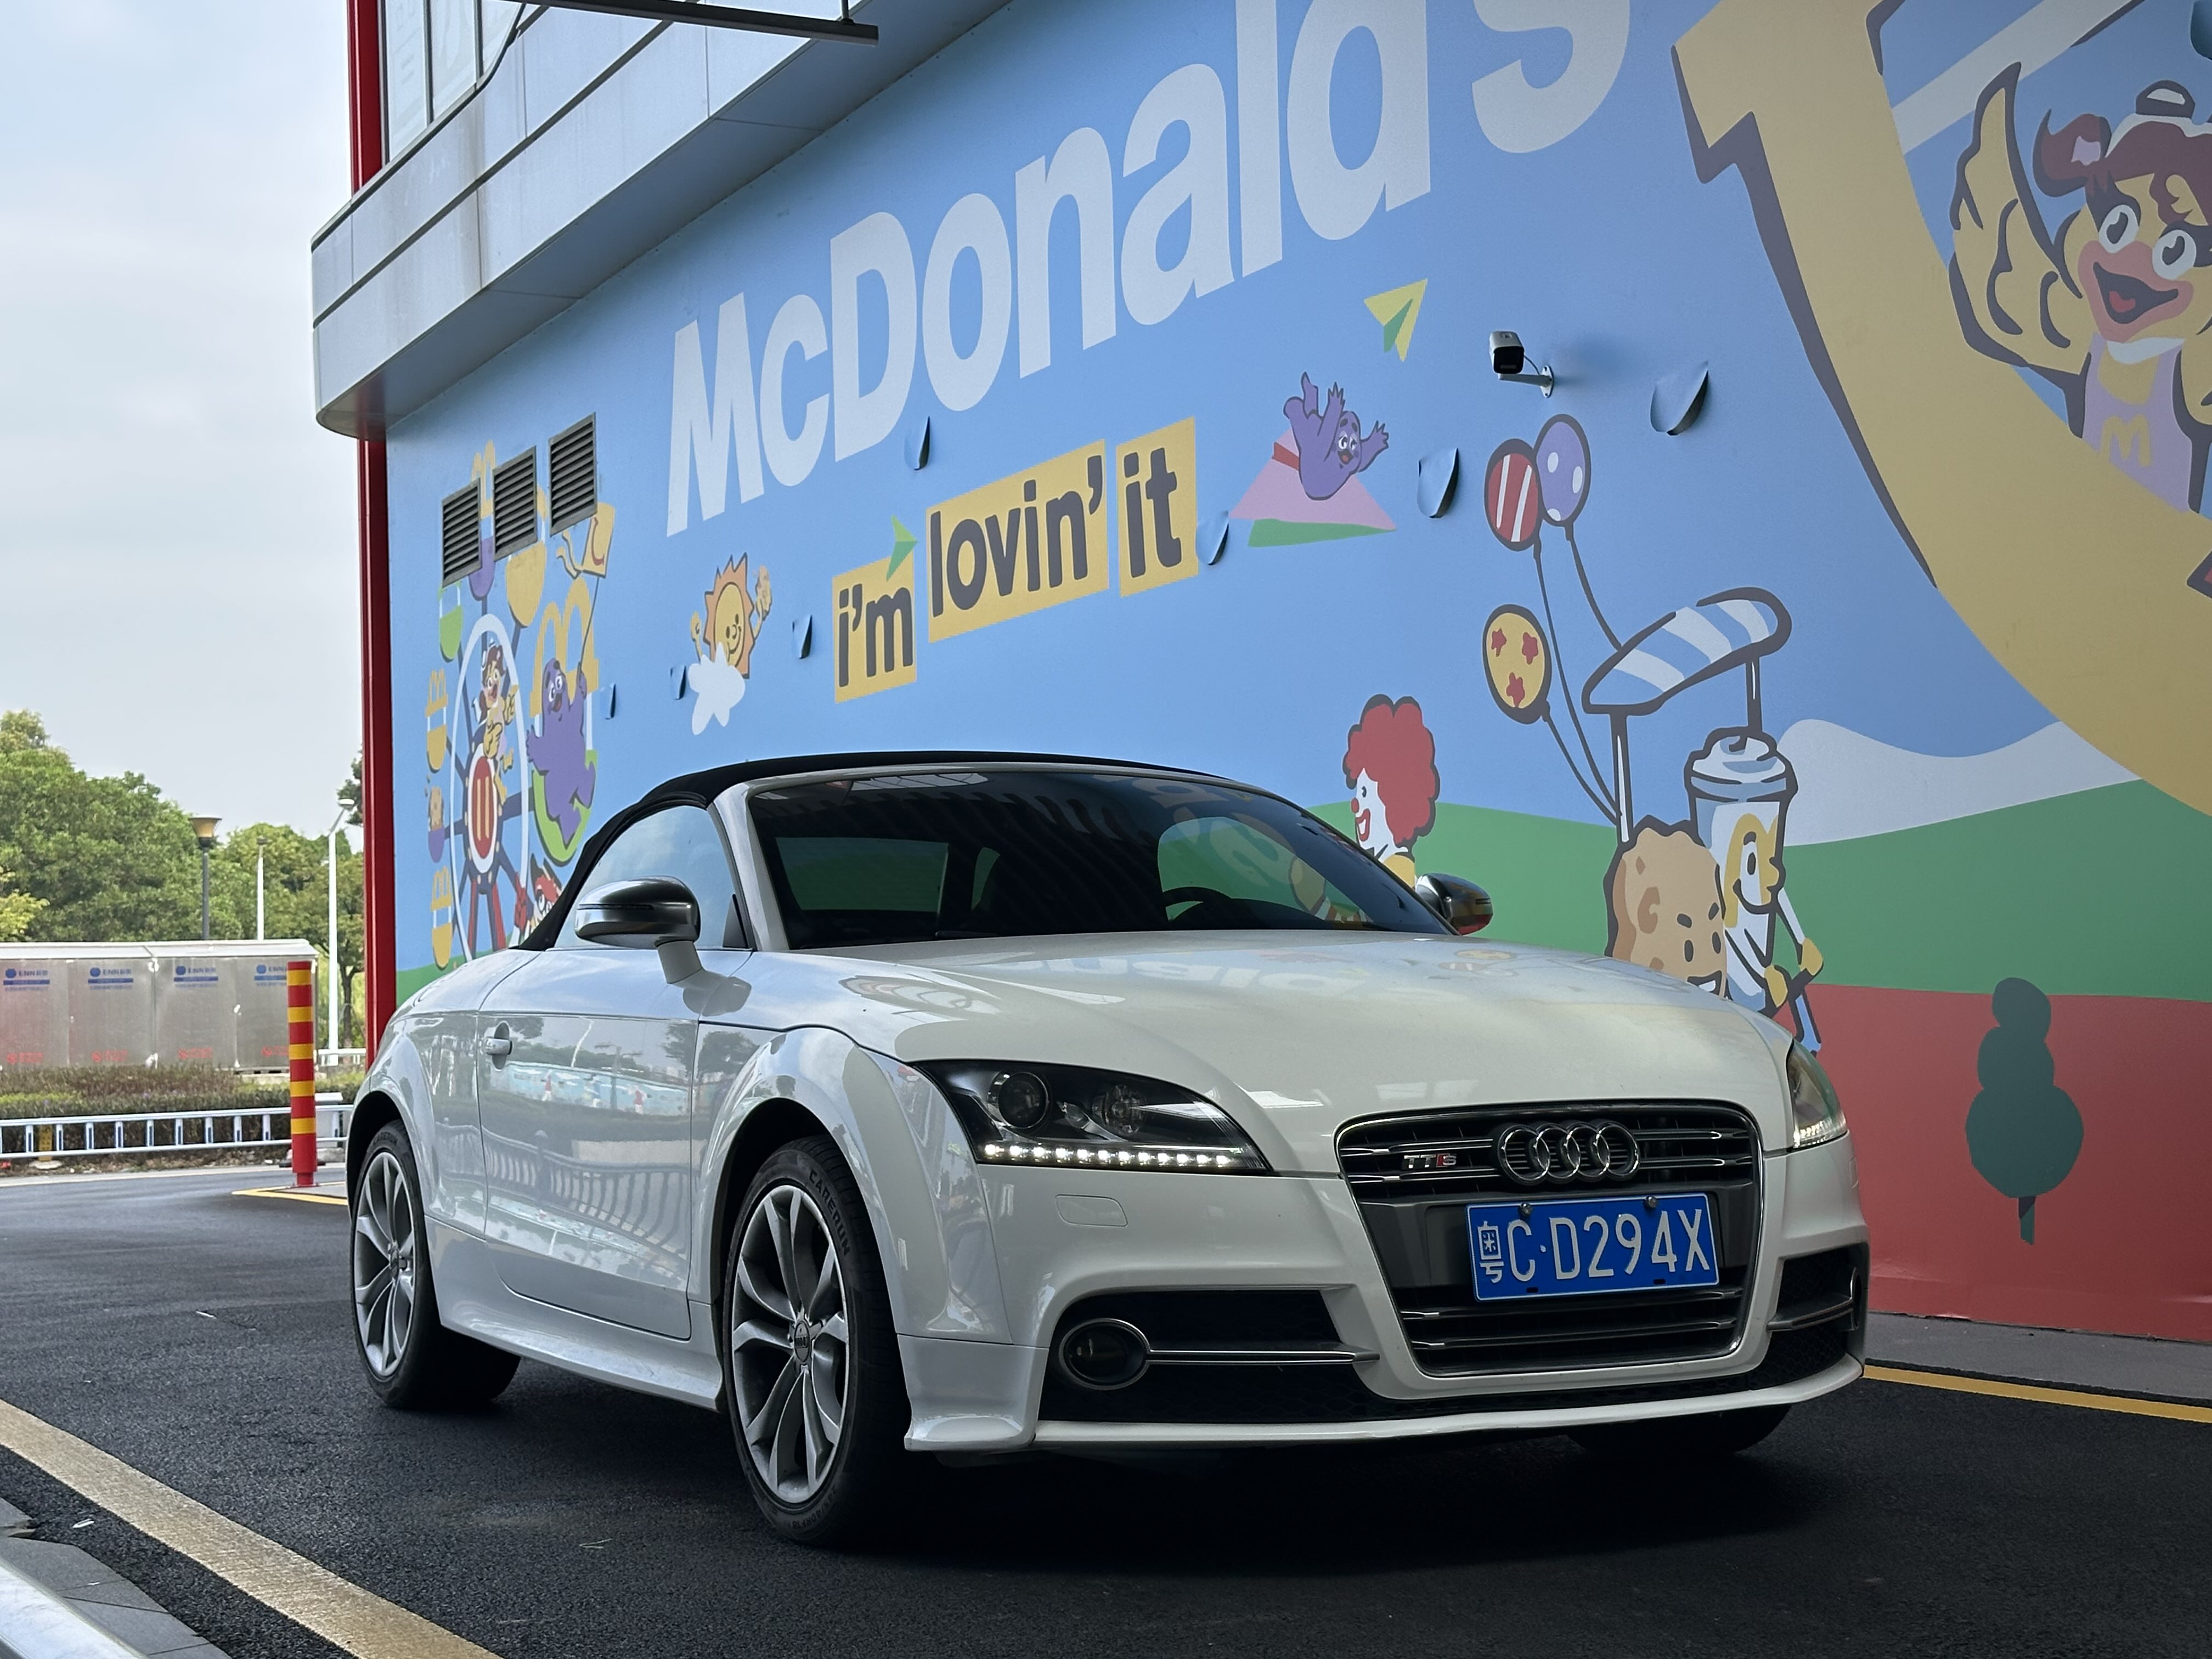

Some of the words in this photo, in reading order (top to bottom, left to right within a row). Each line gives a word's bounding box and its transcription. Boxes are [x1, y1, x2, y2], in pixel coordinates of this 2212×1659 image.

[667, 0, 1630, 538] McDonalds
[839, 584, 913, 687] i'm
[930, 455, 1103, 618] lovin'
[1121, 448, 1183, 578] it
[810, 1169, 850, 1256] CARERUN
[1404, 1153, 1457, 1169] TTS
